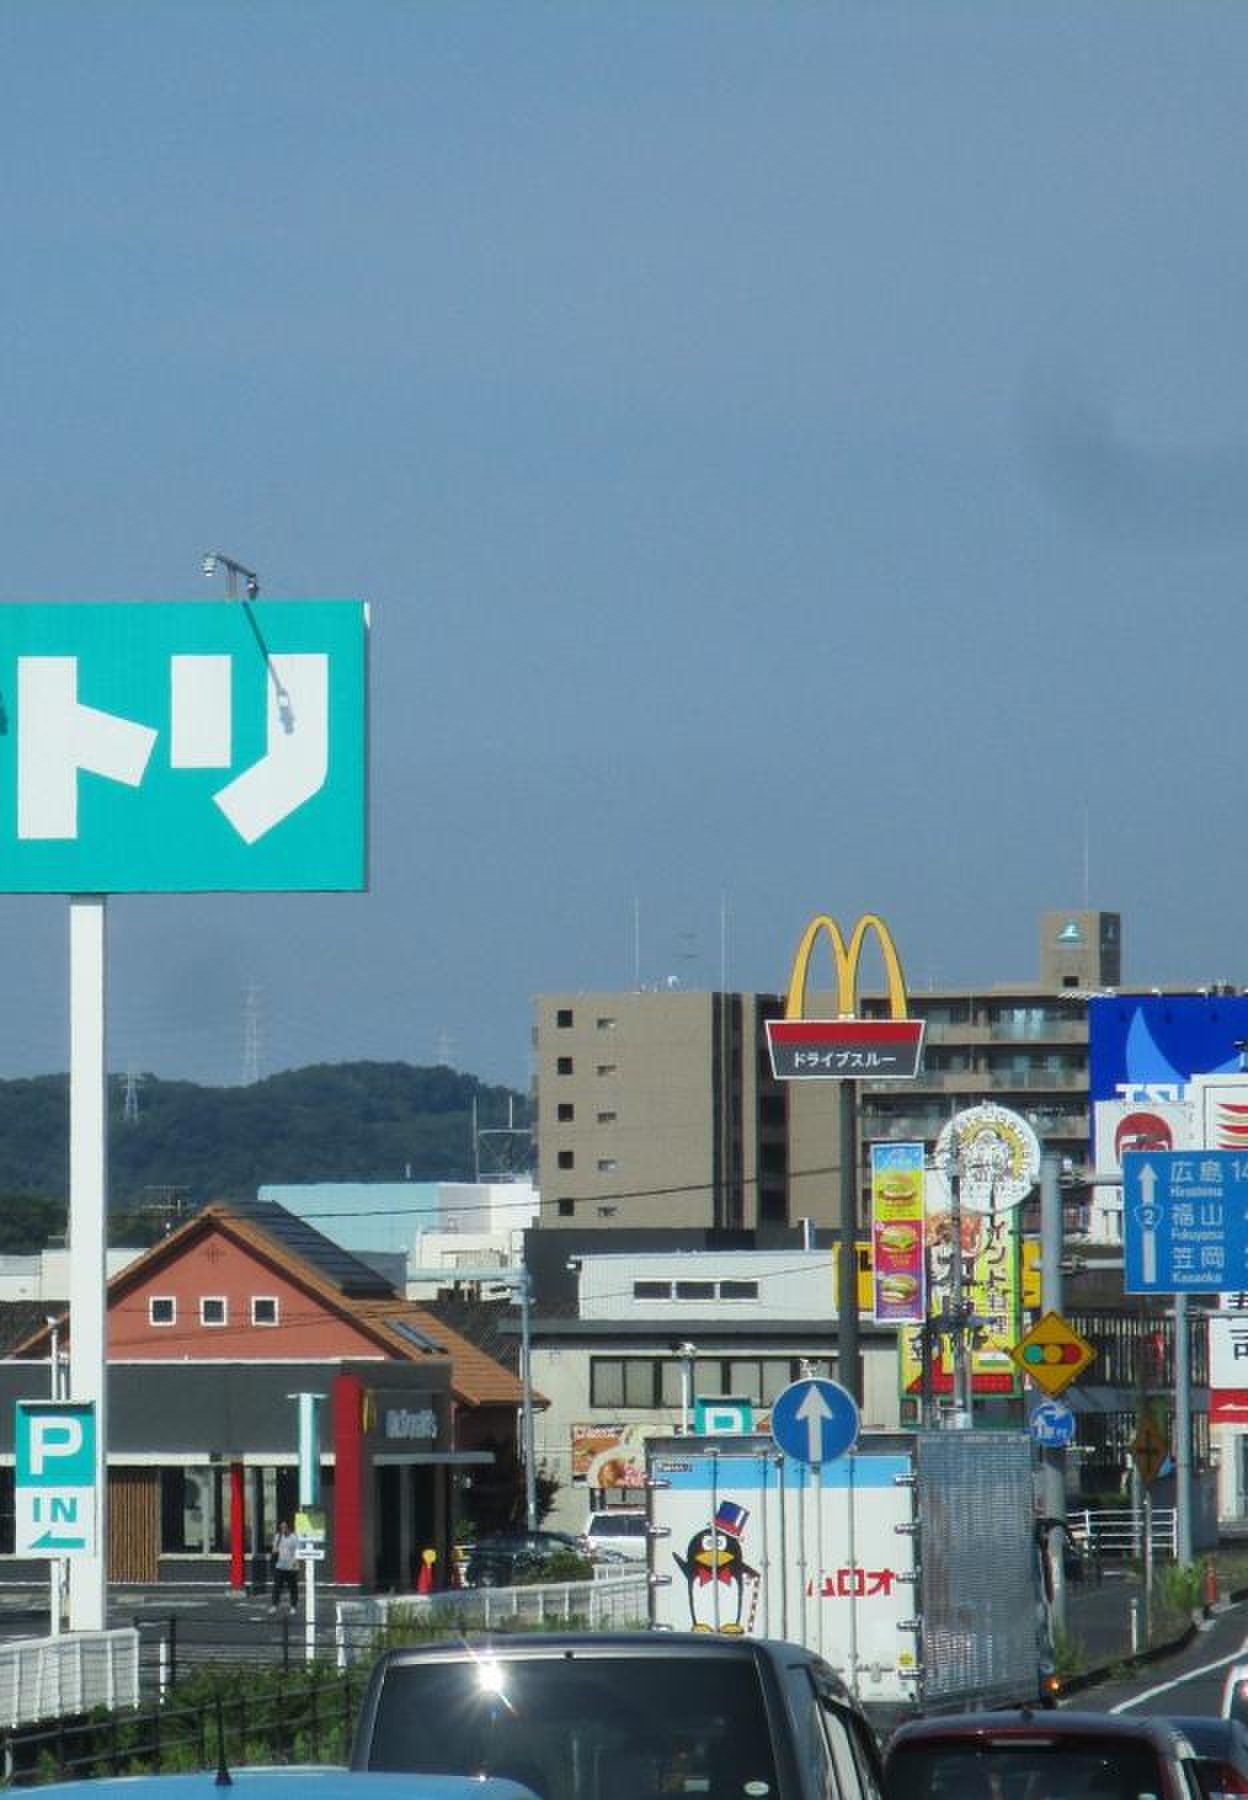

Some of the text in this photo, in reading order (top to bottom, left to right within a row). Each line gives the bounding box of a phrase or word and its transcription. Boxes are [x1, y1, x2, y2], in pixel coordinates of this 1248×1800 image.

[794, 1051, 897, 1069] ドライブスルー
[1171, 1160, 1224, 1183] 広島
[1143, 1208, 1154, 1226] 2
[1171, 1202, 1224, 1228] 福山
[29, 1416, 84, 1476] P
[32, 1496, 78, 1524] IN
